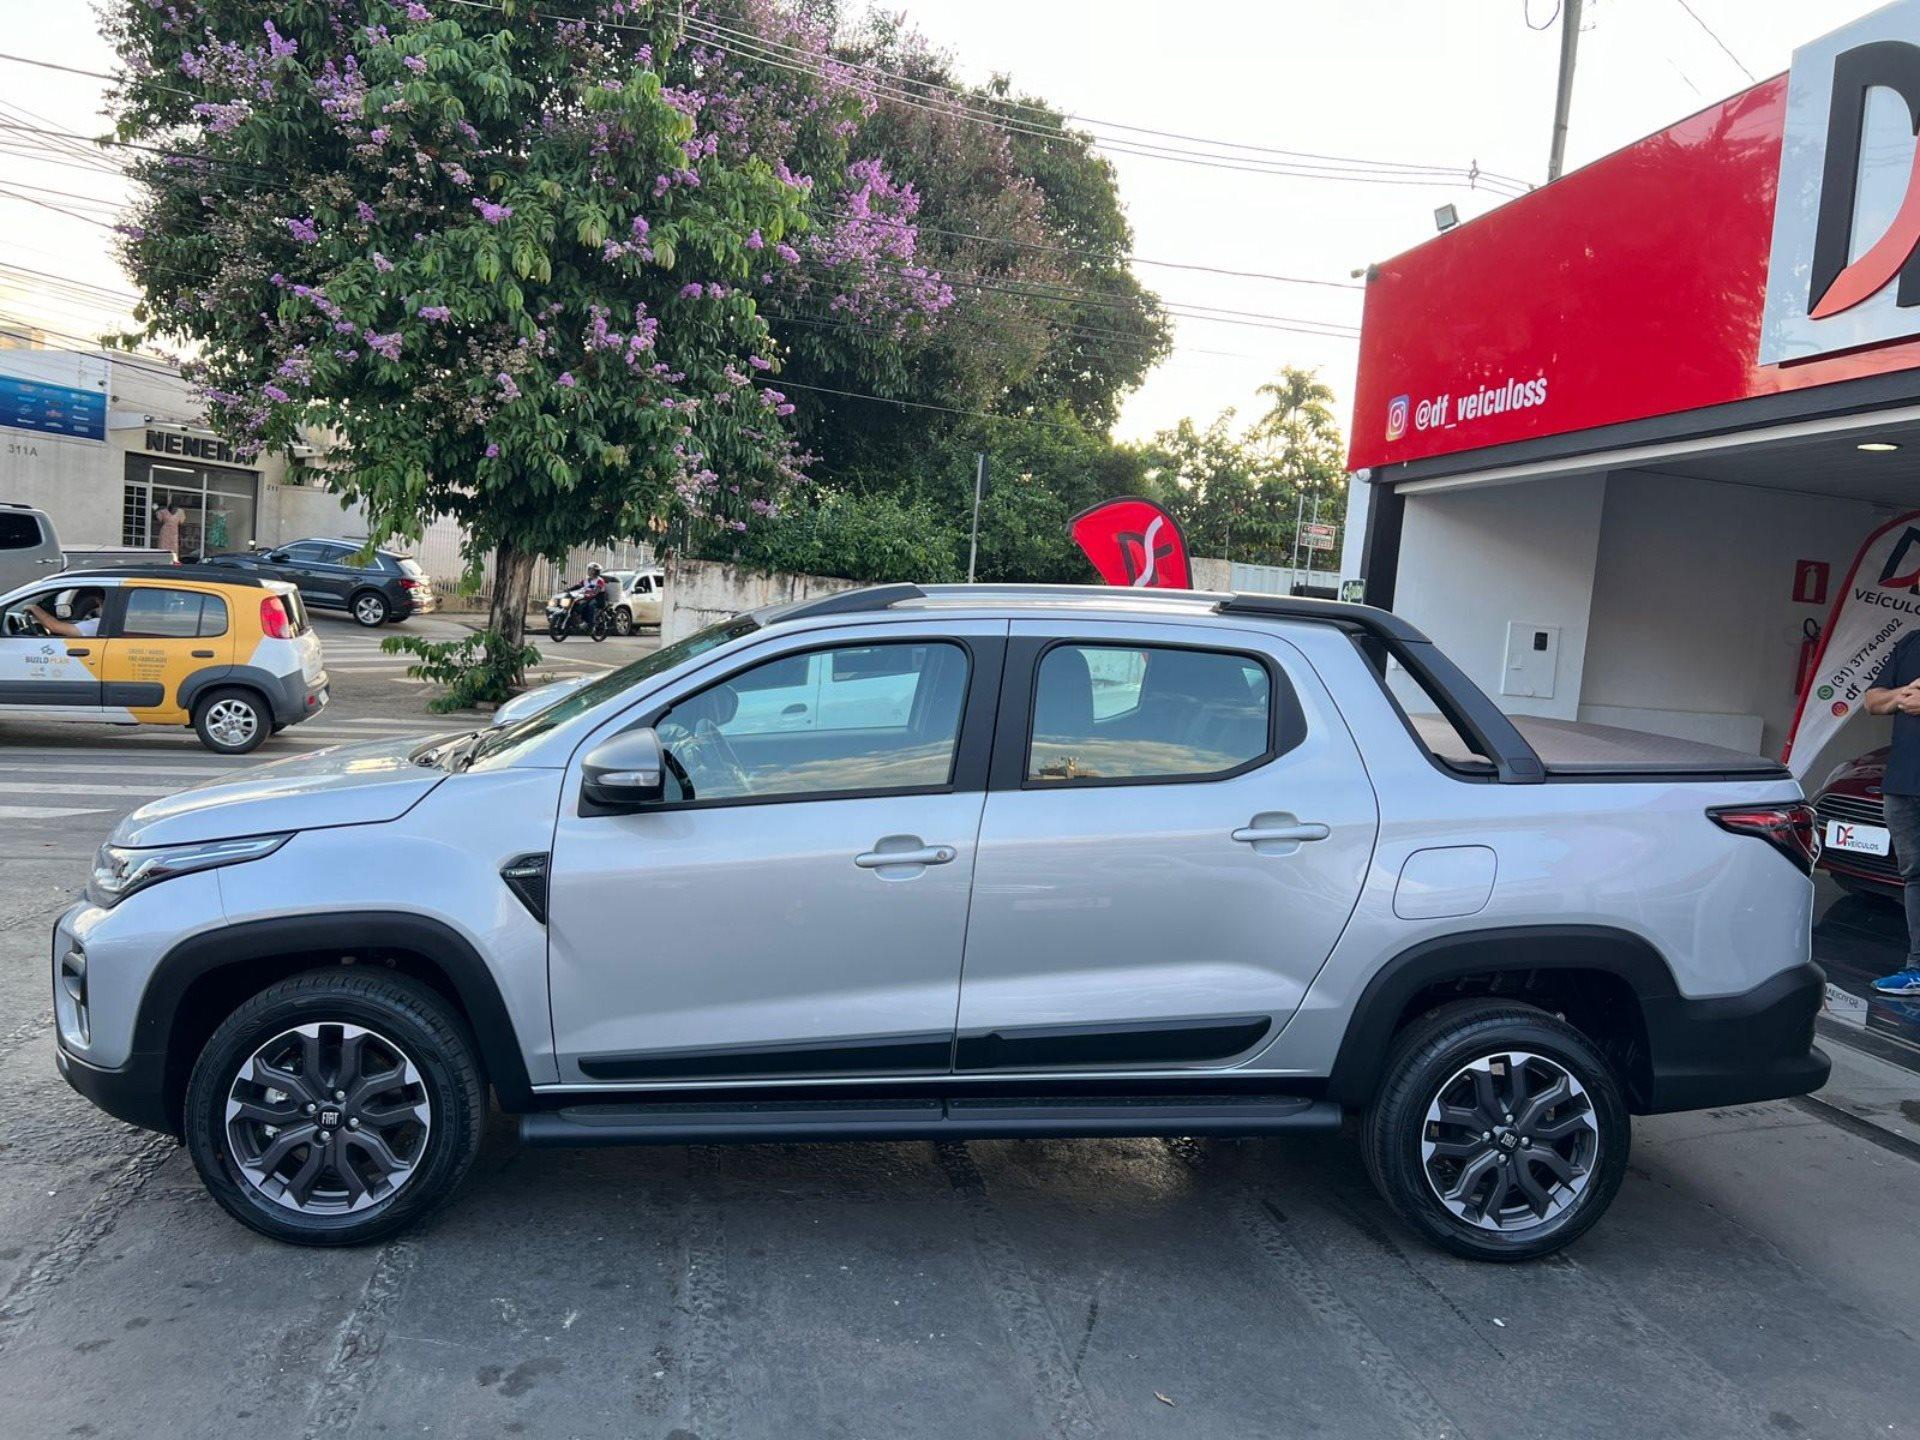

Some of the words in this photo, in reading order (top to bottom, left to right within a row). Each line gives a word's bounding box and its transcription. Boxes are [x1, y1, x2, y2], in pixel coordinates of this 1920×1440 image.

[1415, 377, 1547, 430] @df_veiculoss
[1831, 666, 1855, 689] (31)
[1850, 617, 1903, 668] 3774-0002
[322, 1111, 339, 1125] FIAT
